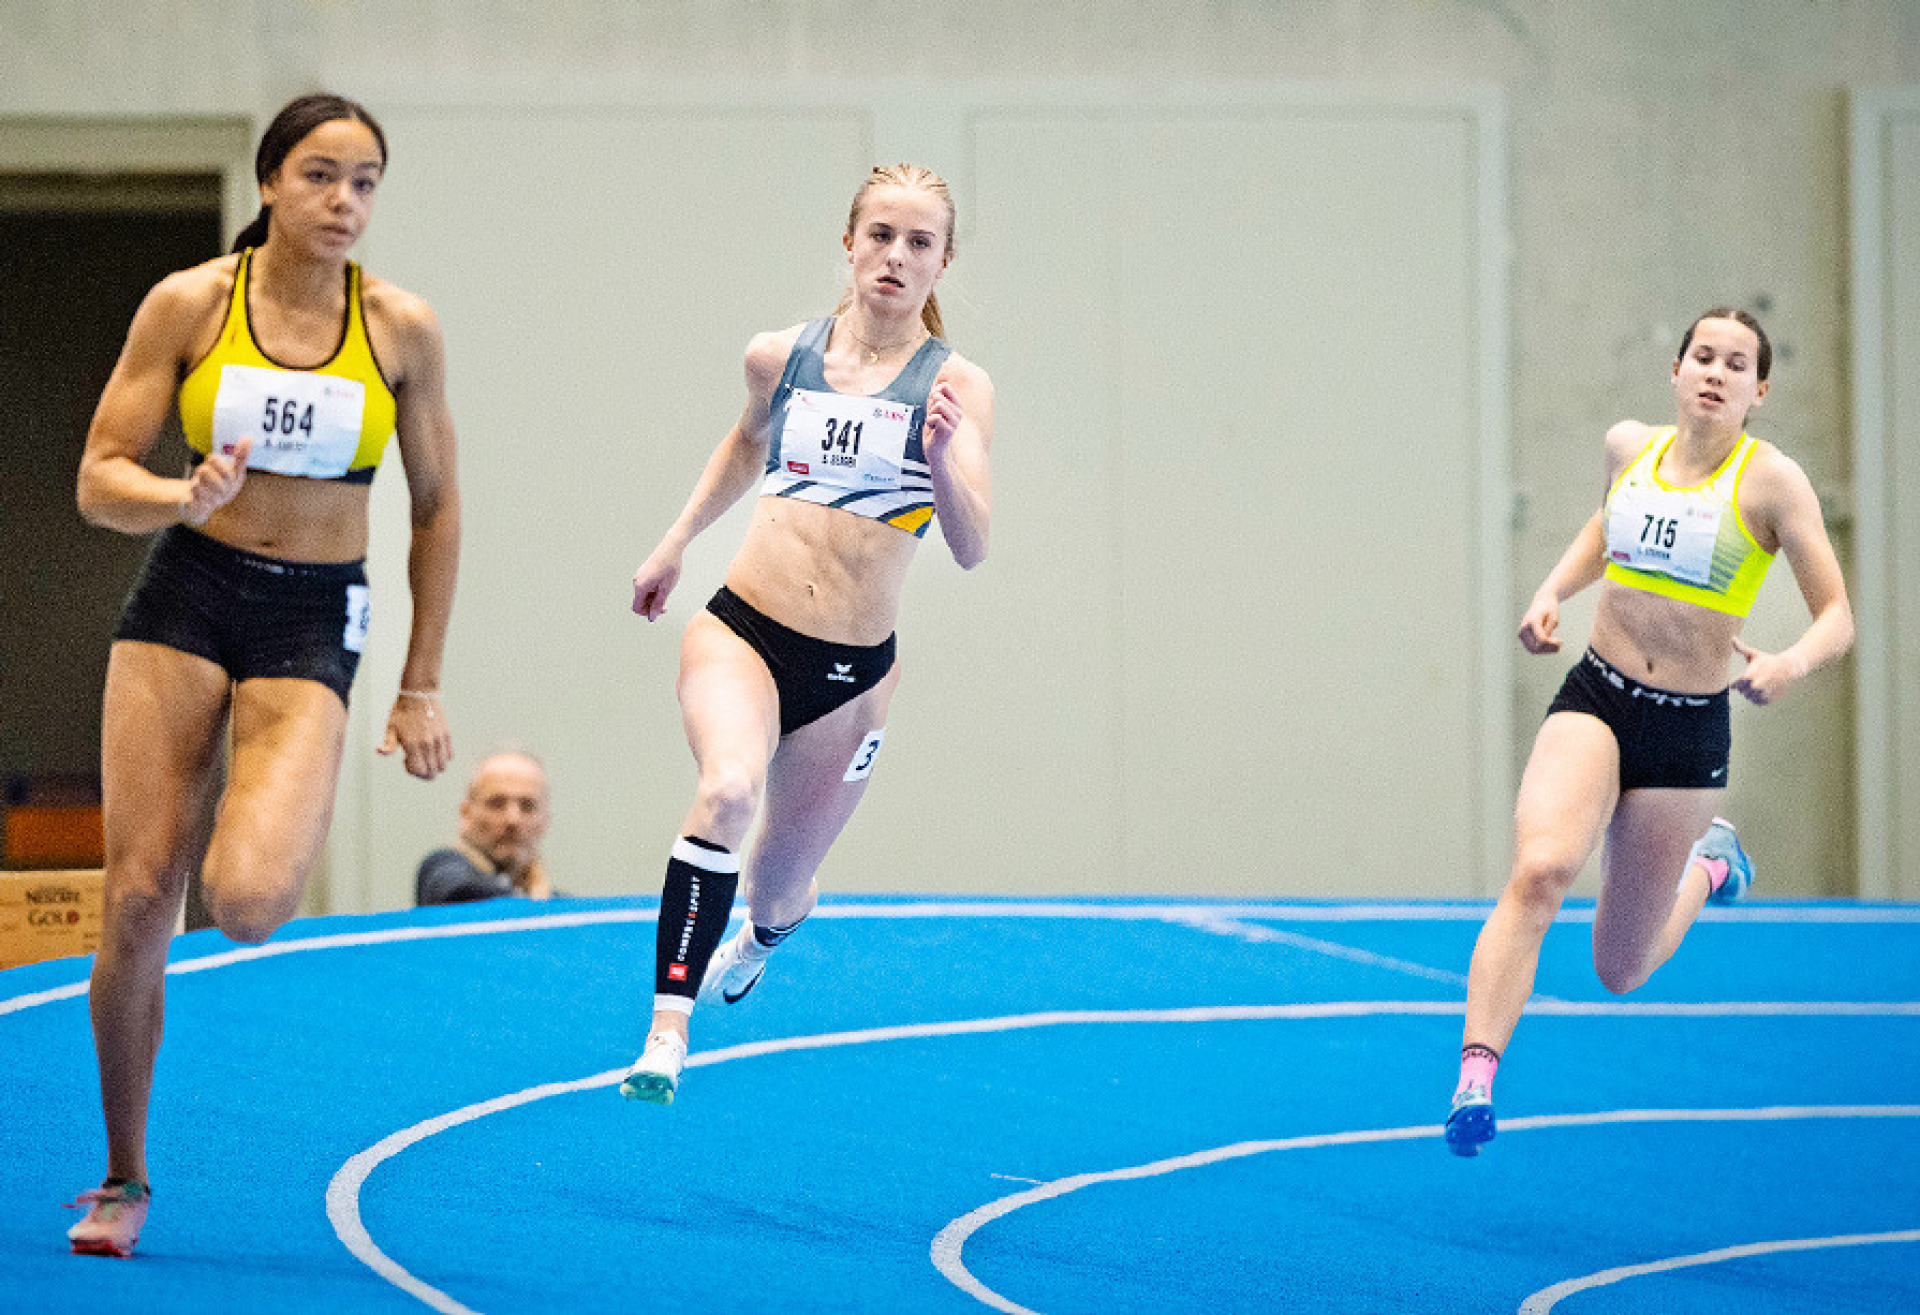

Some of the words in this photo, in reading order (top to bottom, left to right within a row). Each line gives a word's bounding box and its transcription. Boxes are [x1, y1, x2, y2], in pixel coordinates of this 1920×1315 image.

[262, 397, 314, 439] 564
[821, 418, 863, 456] 341
[1640, 514, 1678, 549] 715
[855, 739, 880, 771] 3
